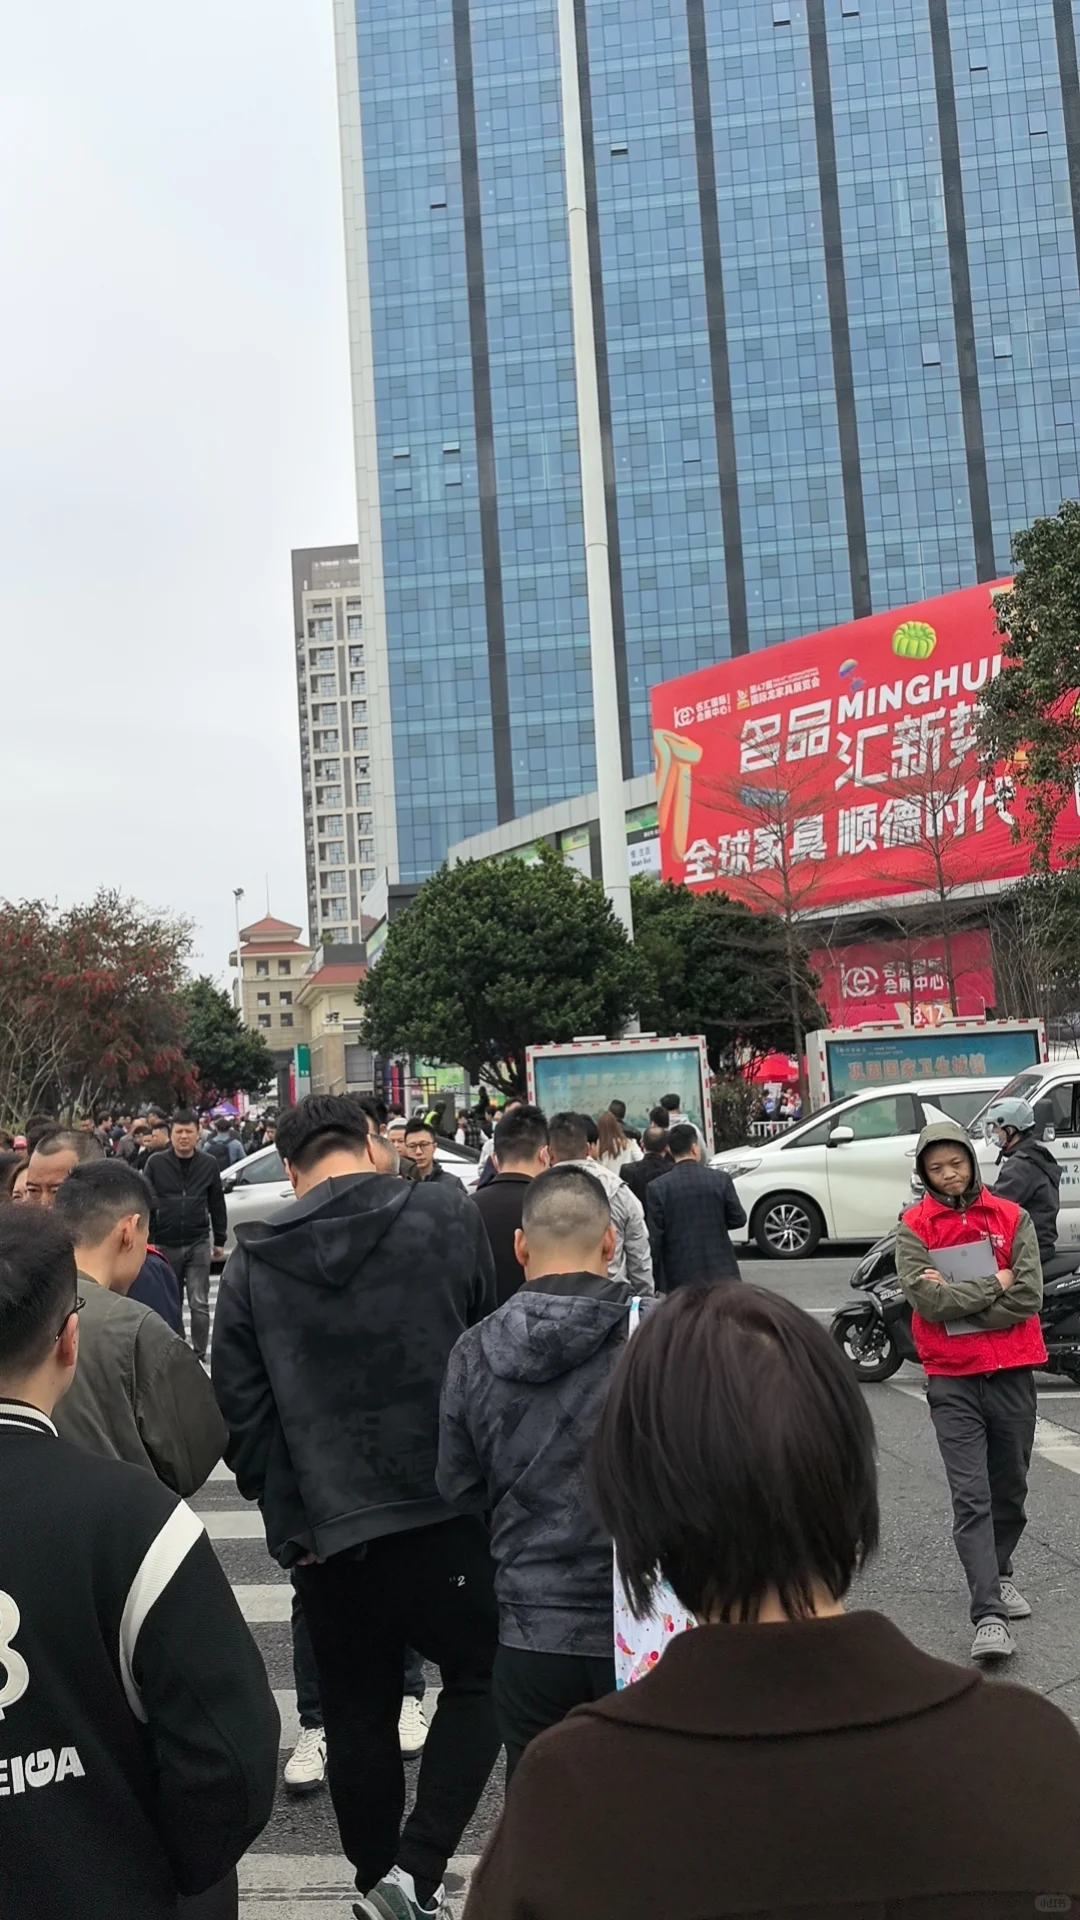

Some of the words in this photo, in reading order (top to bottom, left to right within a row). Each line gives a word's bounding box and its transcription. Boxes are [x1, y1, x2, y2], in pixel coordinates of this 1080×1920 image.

[739, 699, 832, 774] 名品
[683, 814, 828, 885] 全球家具
[837, 775, 1018, 856] 顺德时代
